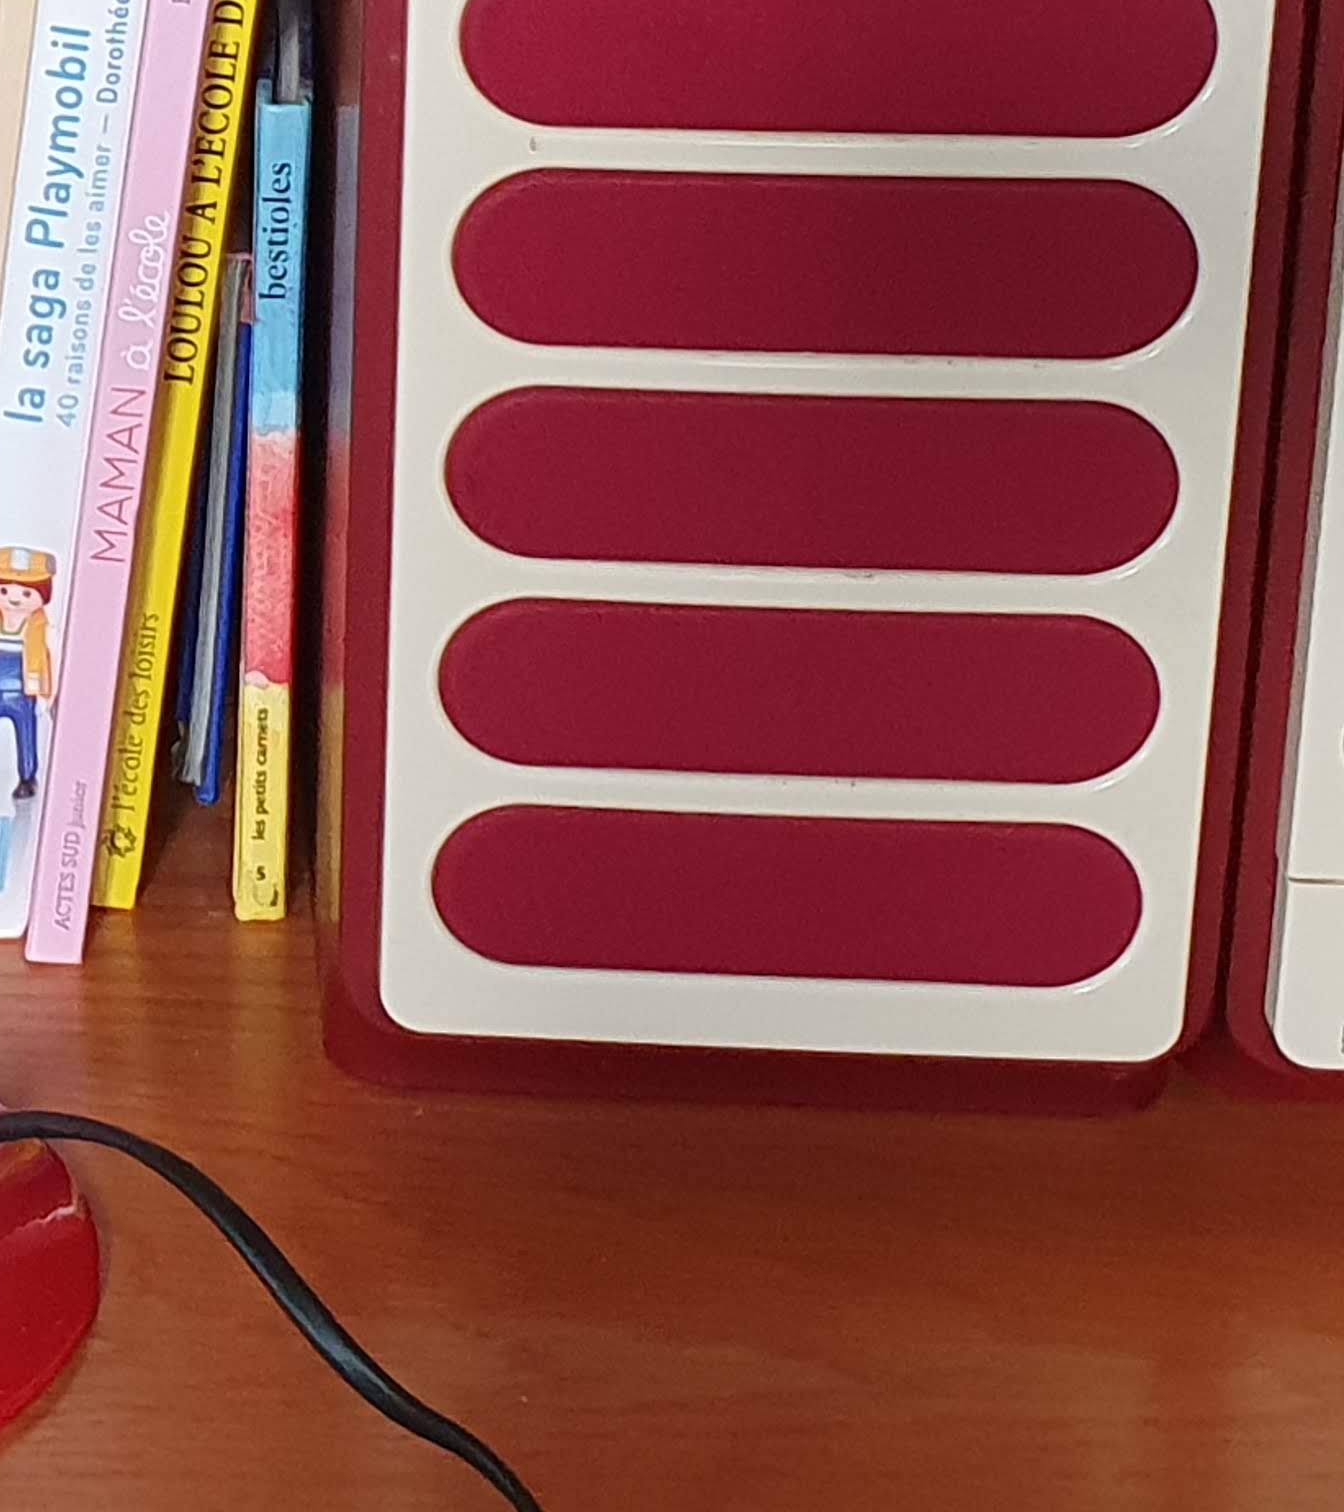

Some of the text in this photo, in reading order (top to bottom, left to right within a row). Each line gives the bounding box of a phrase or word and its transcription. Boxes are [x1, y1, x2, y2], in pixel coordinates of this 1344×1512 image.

[3, 24, 99, 422] la saga Playmobil
[82, 143, 113, 213] aimer
[163, 235, 214, 385] LOULOU
[190, 39, 241, 187] L'ECOLE
[73, 260, 97, 291] de
[77, 218, 102, 255] les
[257, 162, 293, 300] bestioles
[63, 298, 93, 385] raisons
[89, 204, 173, 563] MAMAN à l'école
[55, 392, 79, 426] 40
[122, 610, 161, 727] des loisirs
[53, 829, 81, 931] ACTES SUD
